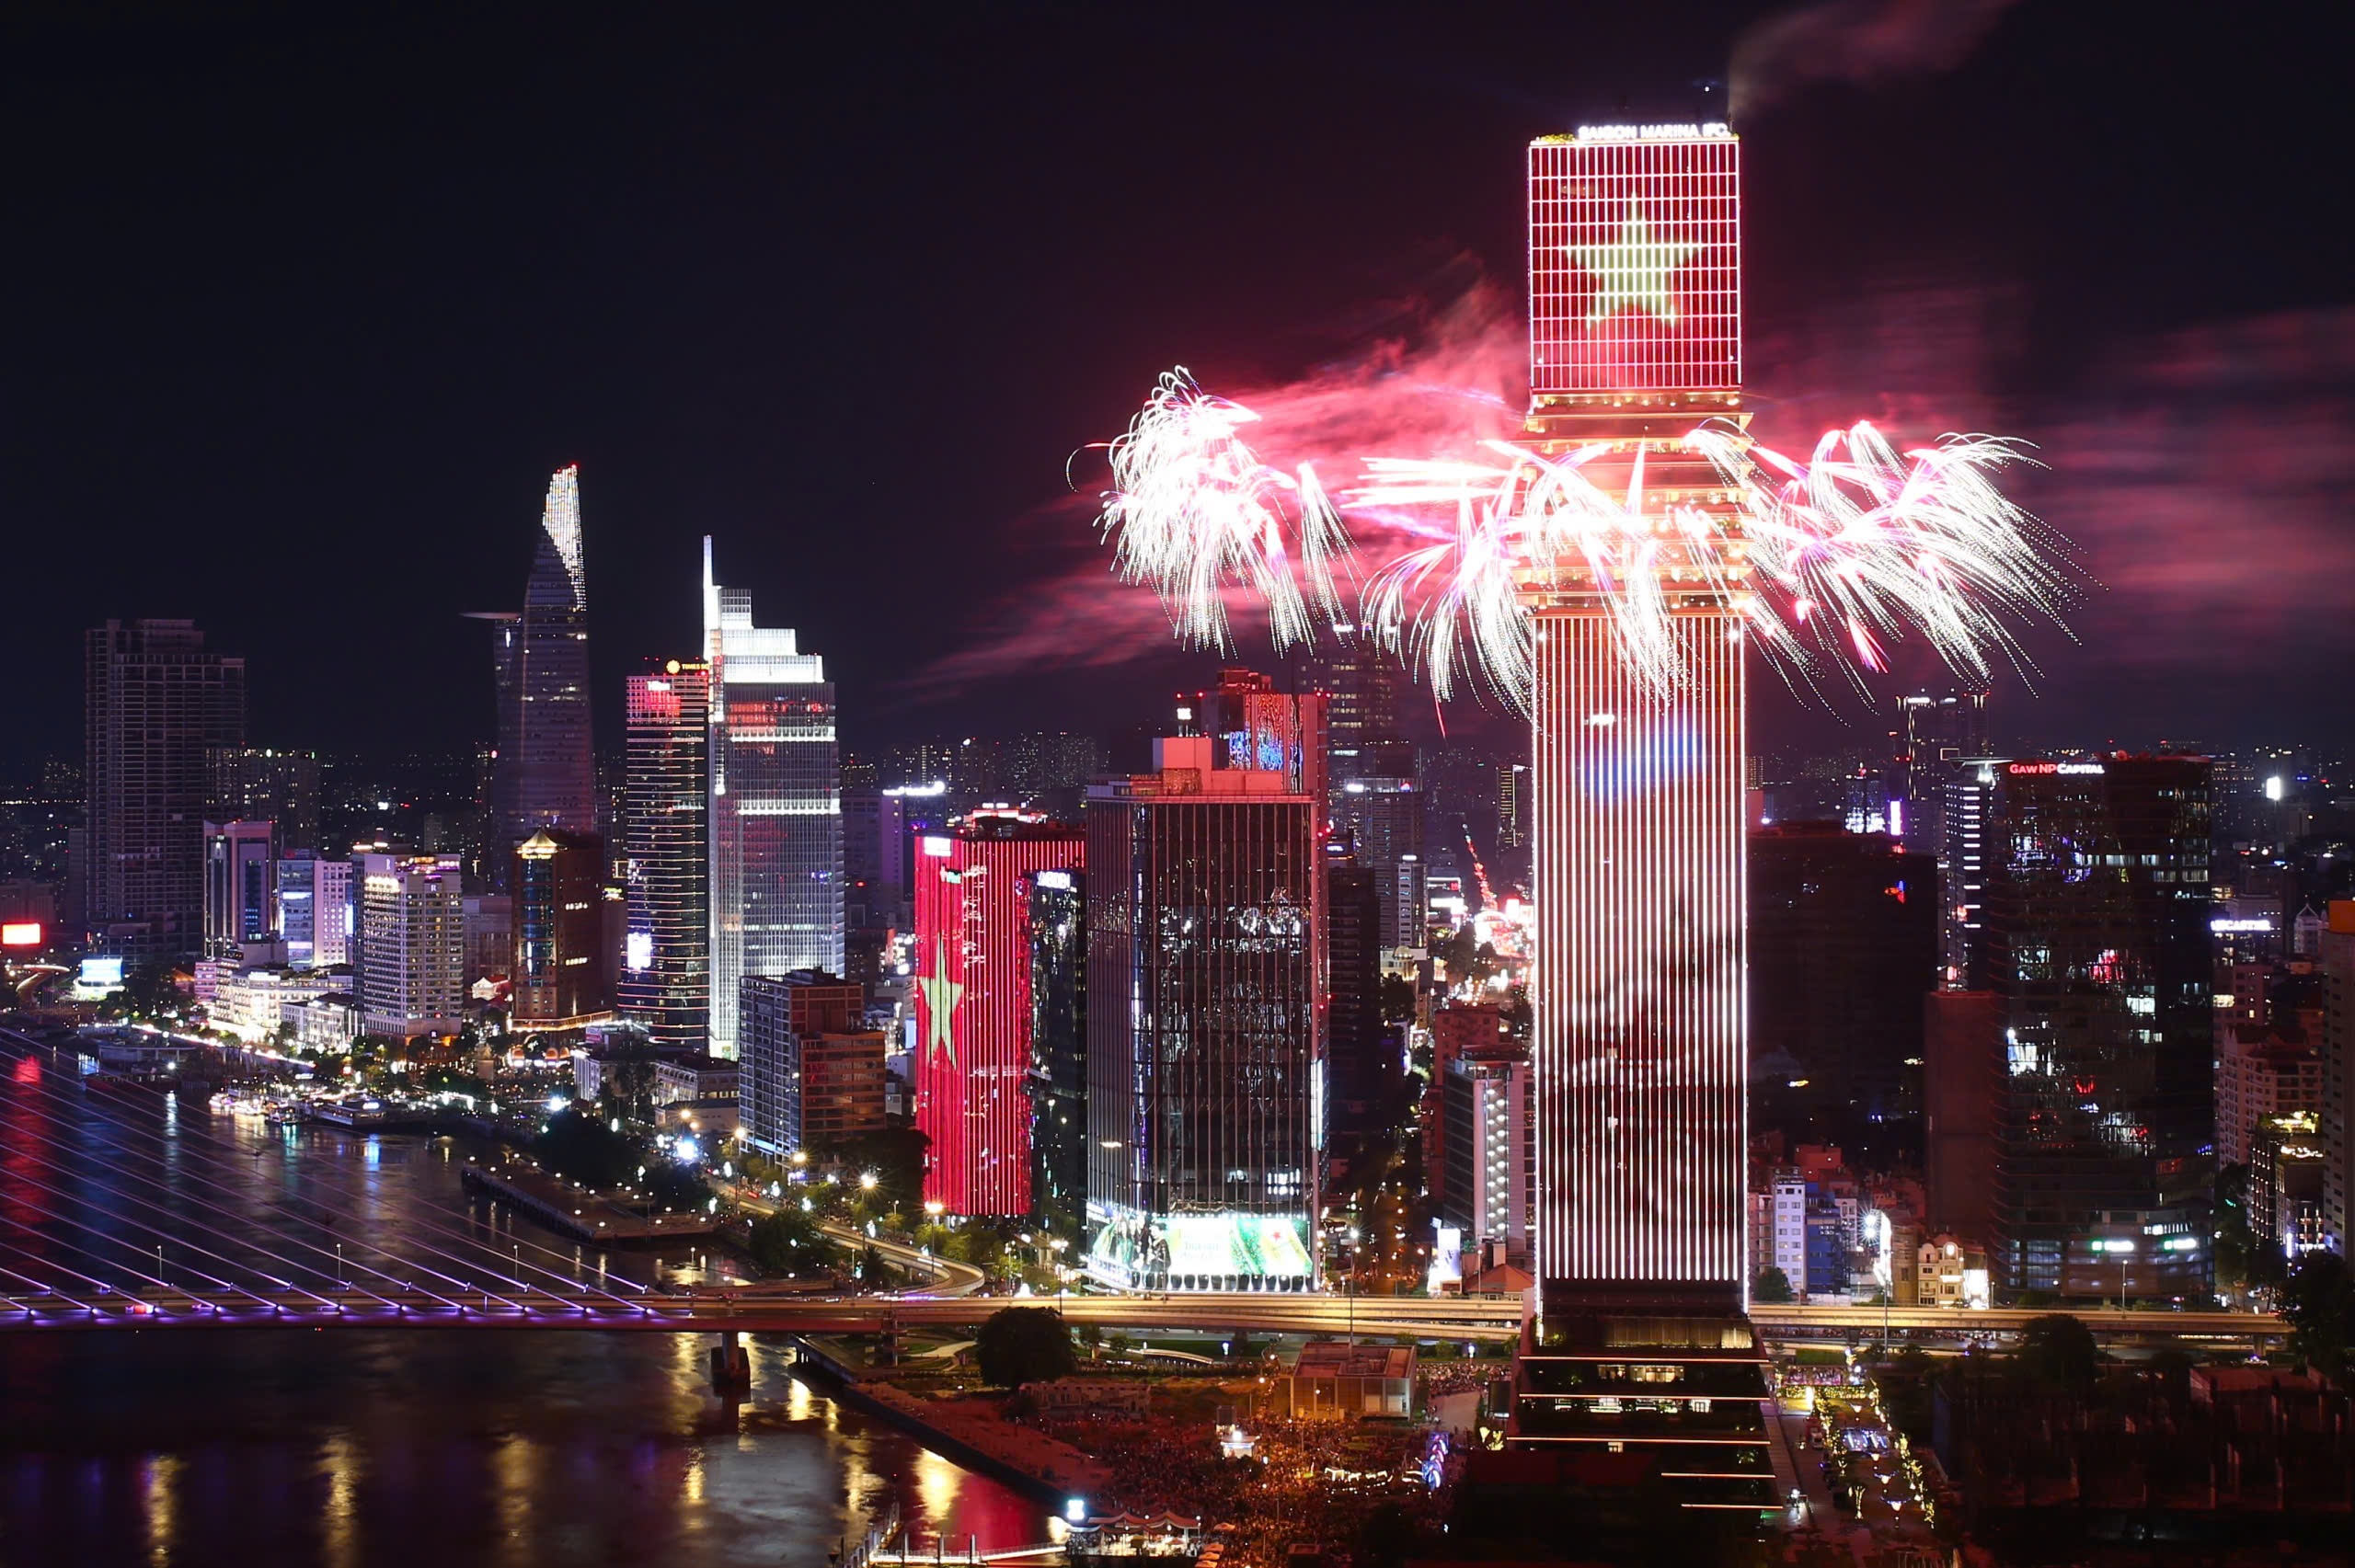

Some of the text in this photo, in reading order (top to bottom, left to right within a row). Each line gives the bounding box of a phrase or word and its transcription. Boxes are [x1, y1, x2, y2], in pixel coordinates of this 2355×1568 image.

[1578, 125, 1637, 140] SAIGON
[1640, 124, 1702, 139] MARINA
[2009, 763, 2038, 774] GAW
[2057, 763, 2105, 774] CAPITAL
